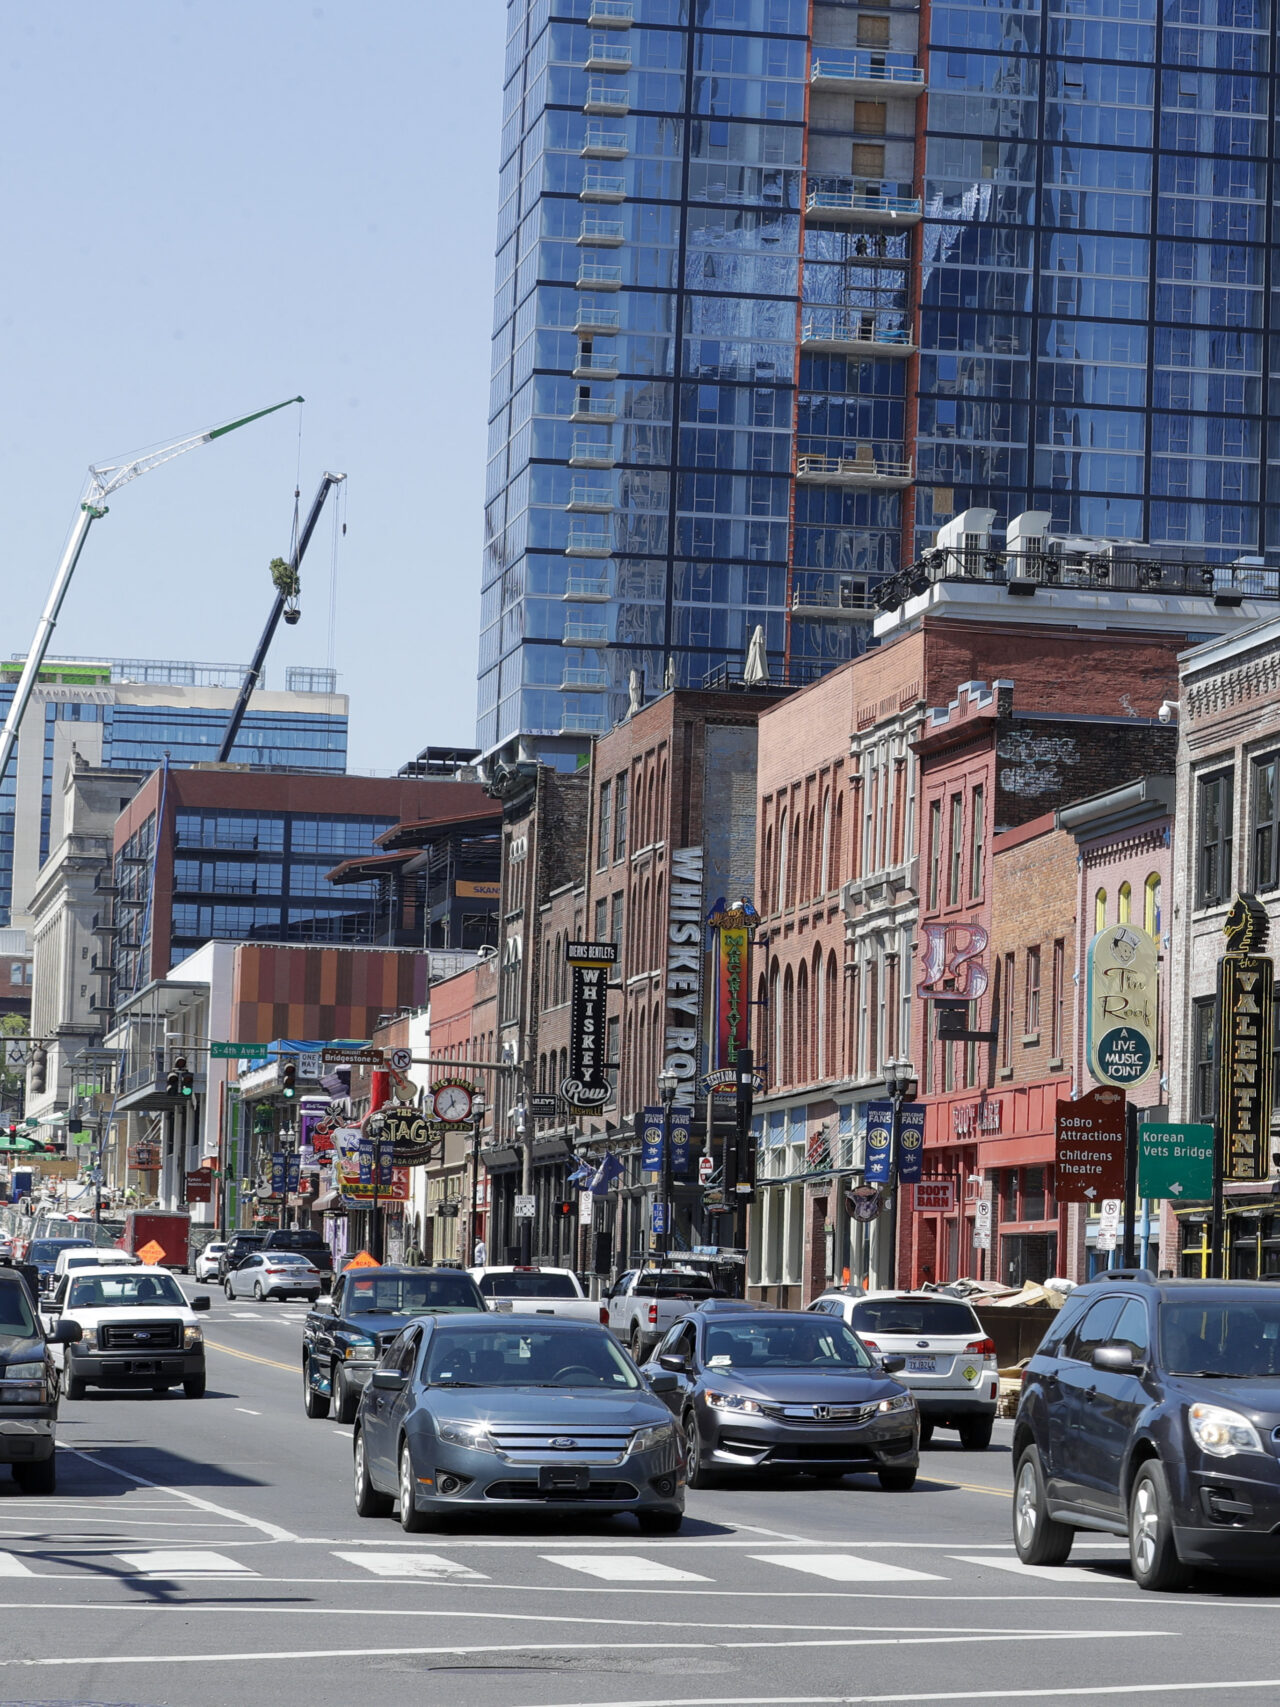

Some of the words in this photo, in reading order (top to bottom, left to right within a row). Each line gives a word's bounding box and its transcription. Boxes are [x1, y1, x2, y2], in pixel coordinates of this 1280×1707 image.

[667, 847, 703, 1016] WHISKEY
[569, 945, 588, 958] DIERKS
[1238, 957, 1259, 968] the
[1104, 967, 1146, 992] Tin
[725, 935, 744, 1063] MARGARITAVILLE
[1098, 995, 1152, 1027] Roof
[581, 969, 600, 1082] WHISKEY
[1120, 1028, 1129, 1038] A
[1112, 1041, 1136, 1051] LIVE
[324, 1054, 371, 1063] Bridgestone
[1105, 1053, 1144, 1064] MUSIC
[1107, 1066, 1142, 1076] JOINT
[1232, 971, 1261, 1178] VALENTINE
[706, 1070, 737, 1087] RESTAURA
[566, 1080, 606, 1105] Row
[396, 1108, 412, 1117] THE
[644, 1116, 664, 1124] FANS
[671, 1117, 690, 1125] FANS
[868, 1115, 892, 1124] FANS
[901, 1116, 924, 1125] FANS
[1060, 1117, 1093, 1128] SoBro
[646, 1129, 660, 1143] SEC
[871, 1129, 886, 1147] SEC
[903, 1131, 919, 1148] SEC
[1060, 1131, 1122, 1142] Attractions
[1143, 1132, 1185, 1142] Korean
[1060, 1150, 1113, 1161] Childrens
[1143, 1146, 1169, 1156] Vets
[1174, 1147, 1213, 1159] Bridge
[1060, 1164, 1103, 1174] Theatre
[917, 1185, 950, 1197] BOOT
[917, 1197, 949, 1208] BARN
